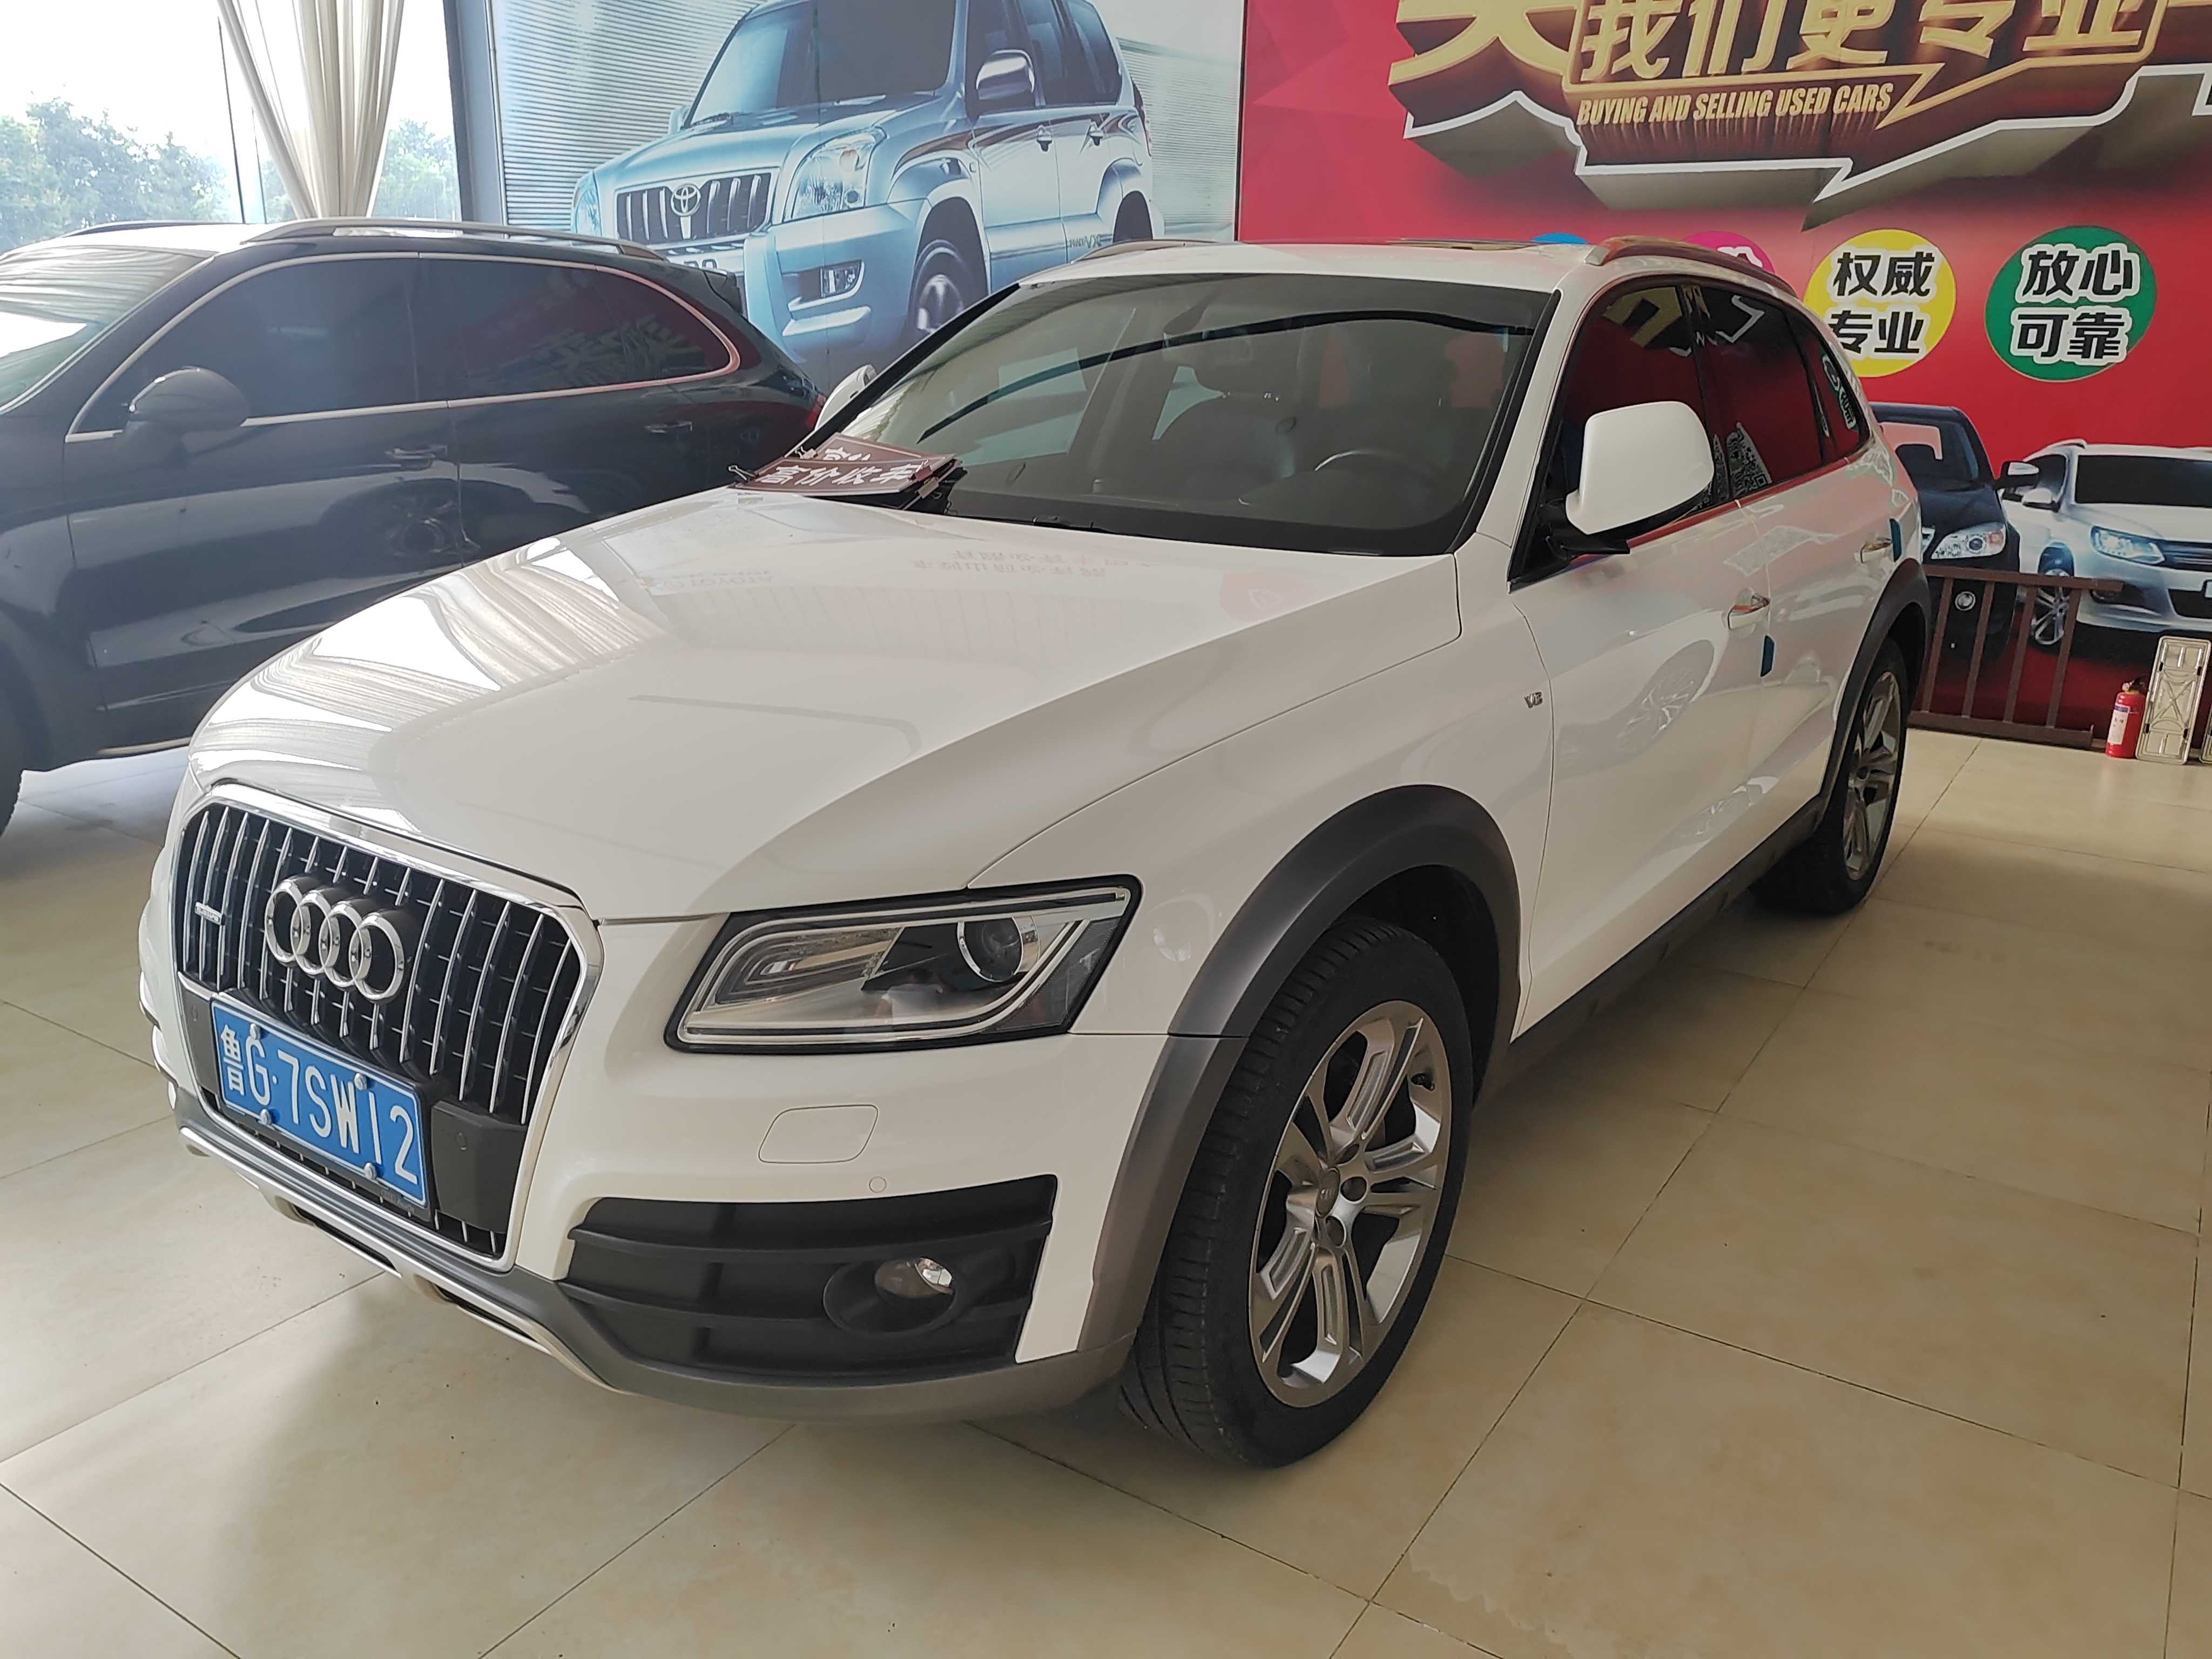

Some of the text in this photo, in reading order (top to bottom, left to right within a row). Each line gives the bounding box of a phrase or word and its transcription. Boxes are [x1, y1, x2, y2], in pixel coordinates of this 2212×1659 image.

[1576, 82, 1893, 125] BUYING AND SELLING USED CARS
[1833, 251, 1935, 296] 权威
[2022, 250, 2133, 296] 放心
[1827, 310, 1925, 354] 专业
[2017, 312, 2125, 359] 可靠
